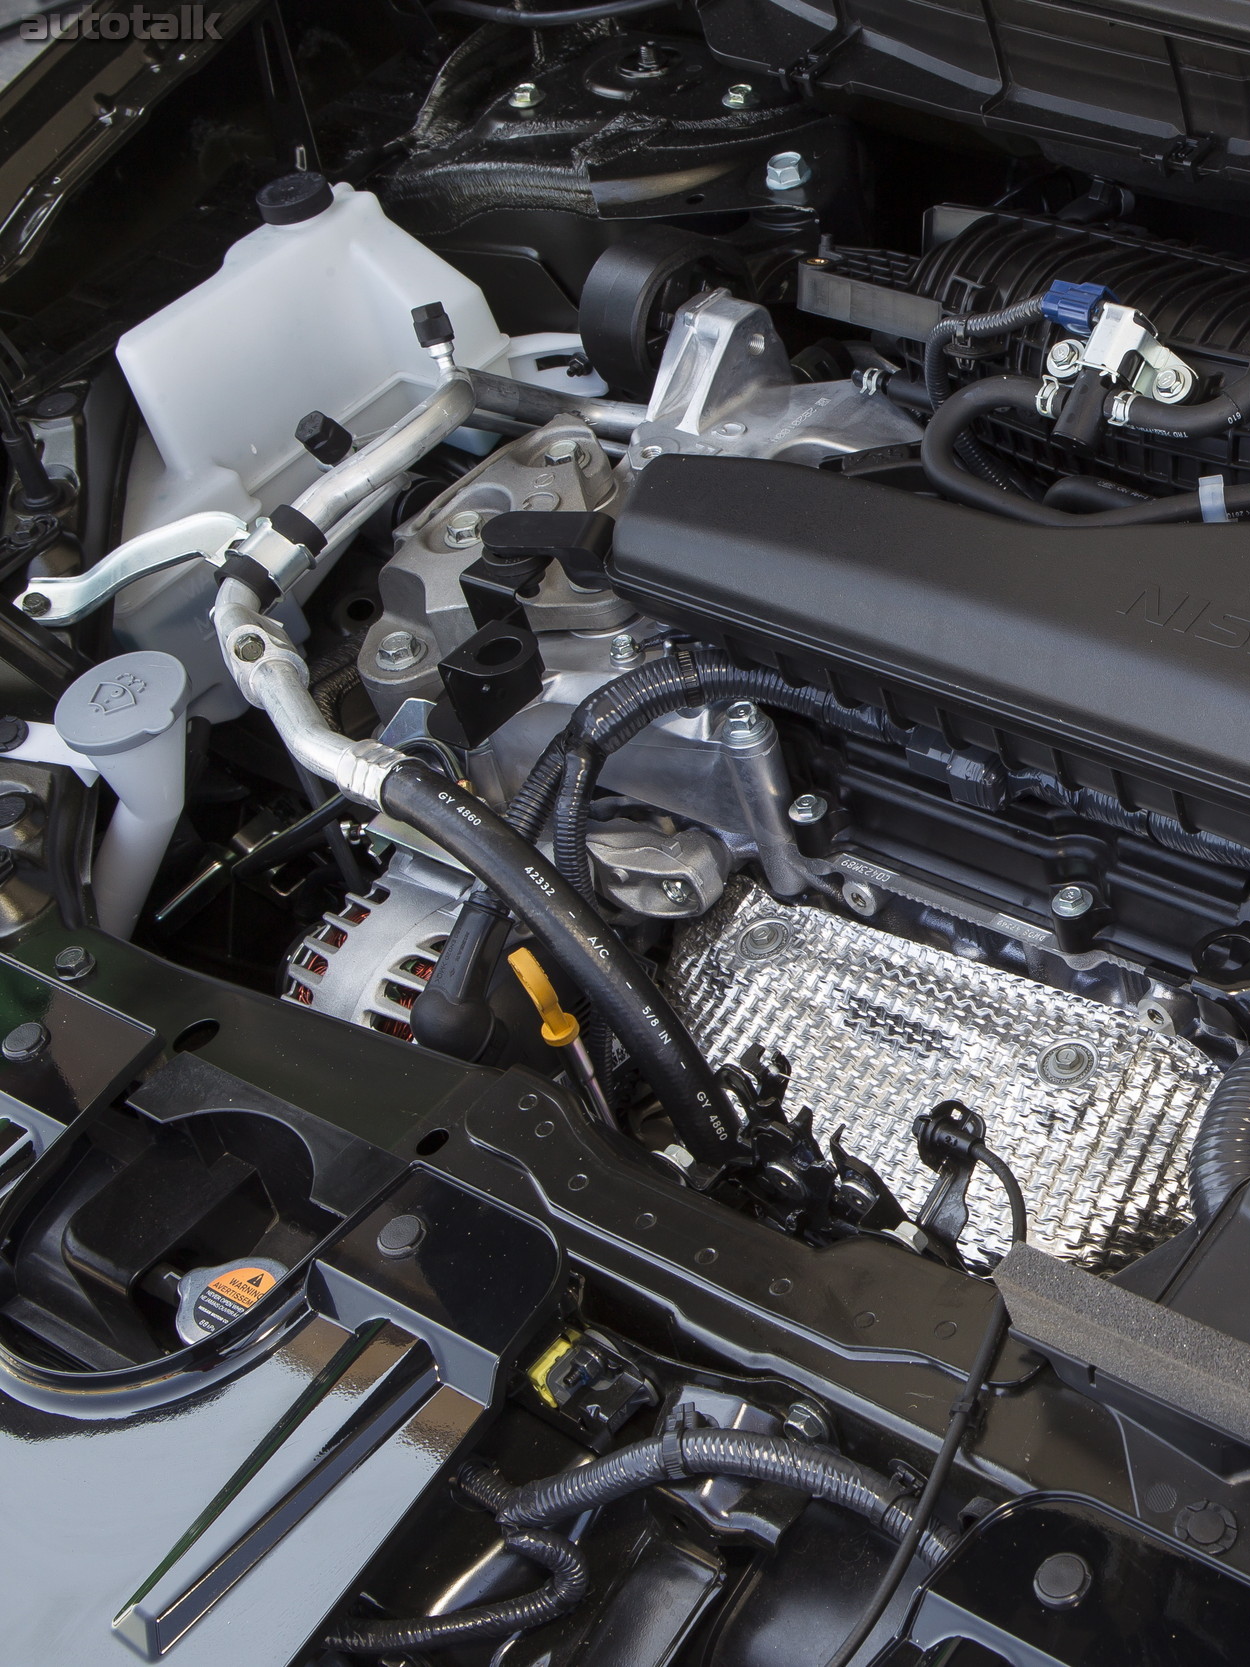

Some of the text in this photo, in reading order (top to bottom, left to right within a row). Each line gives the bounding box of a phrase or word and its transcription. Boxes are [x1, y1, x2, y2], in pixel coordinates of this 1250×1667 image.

[437, 791, 482, 826] GY 4860
[523, 866, 556, 897] 42332
[586, 935, 610, 959] A/C
[641, 1005, 672, 1046] 5/8 IN
[696, 1090, 728, 1141] GY 4860
